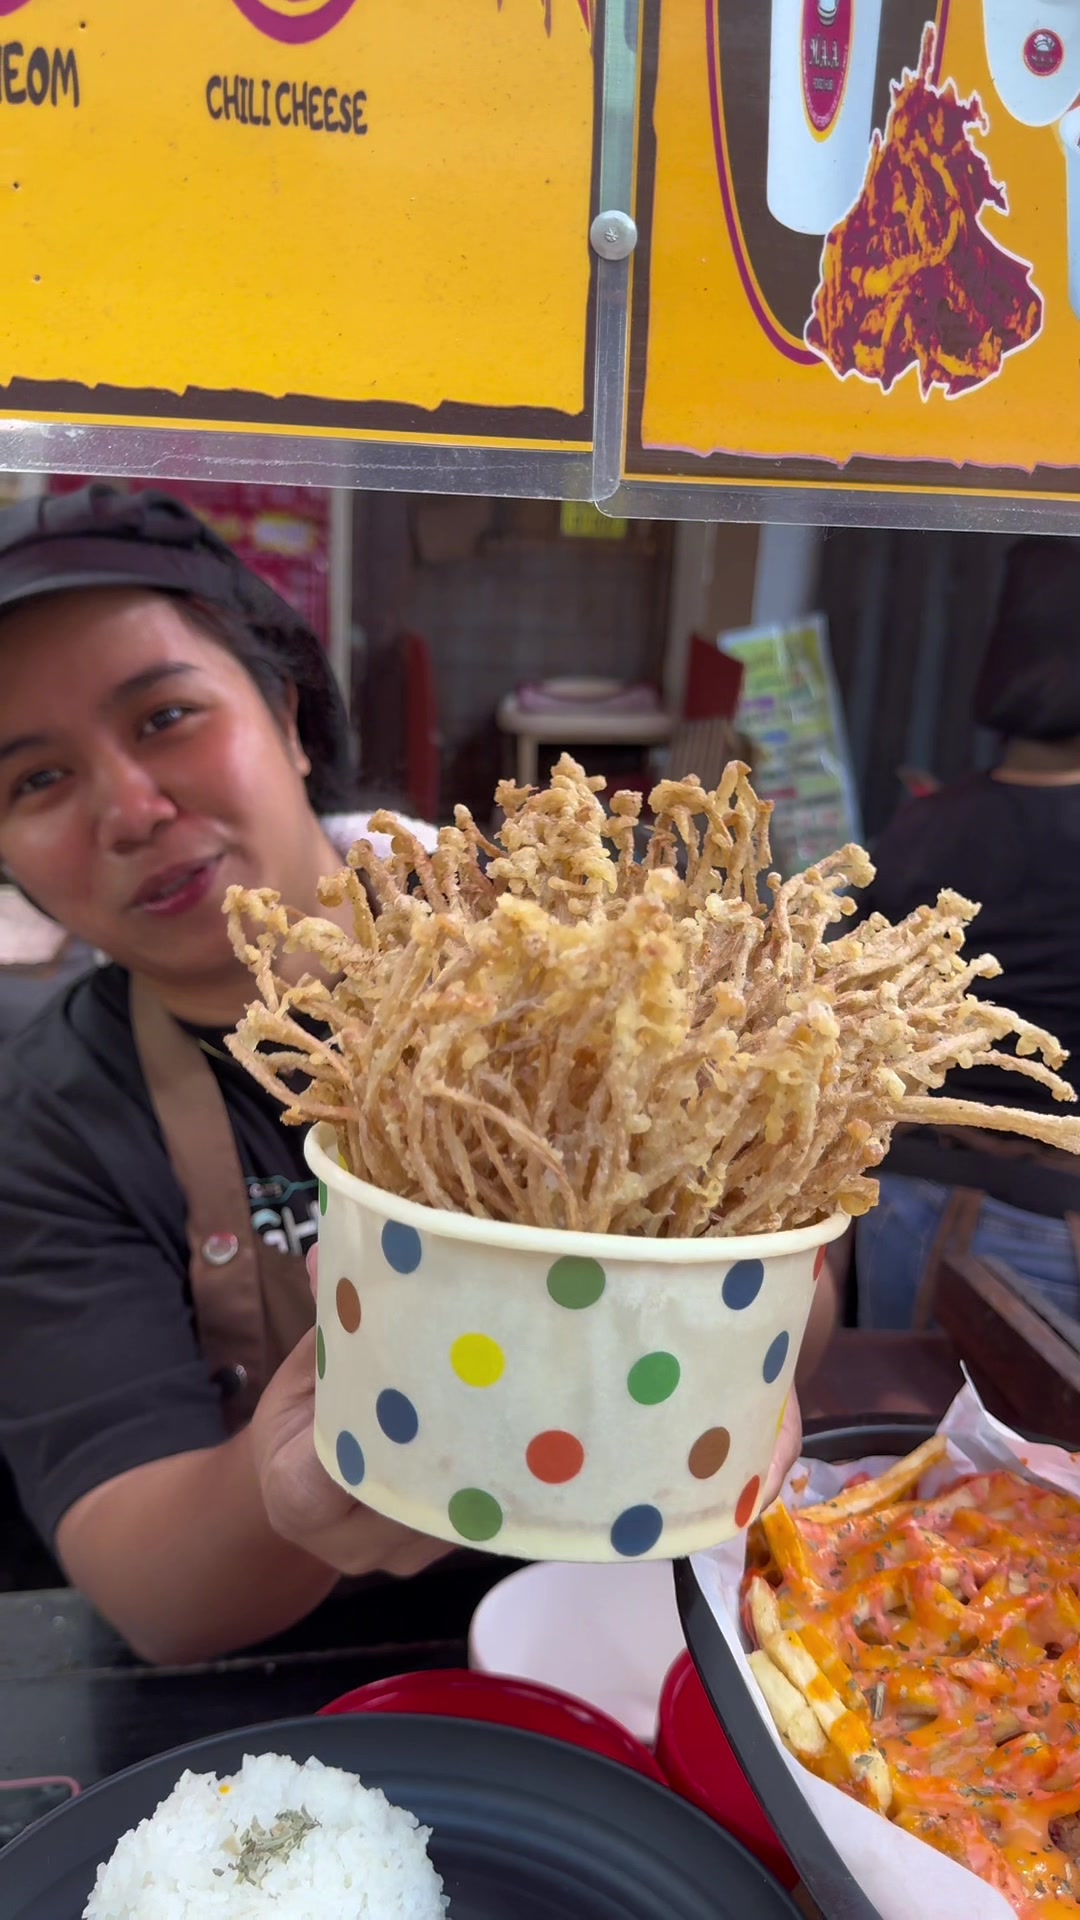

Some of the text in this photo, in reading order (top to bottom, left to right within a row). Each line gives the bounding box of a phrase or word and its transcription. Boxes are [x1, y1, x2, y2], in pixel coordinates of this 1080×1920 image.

[0, 41, 80, 109] EOM
[206, 74, 368, 135] CHILI CHEESE
